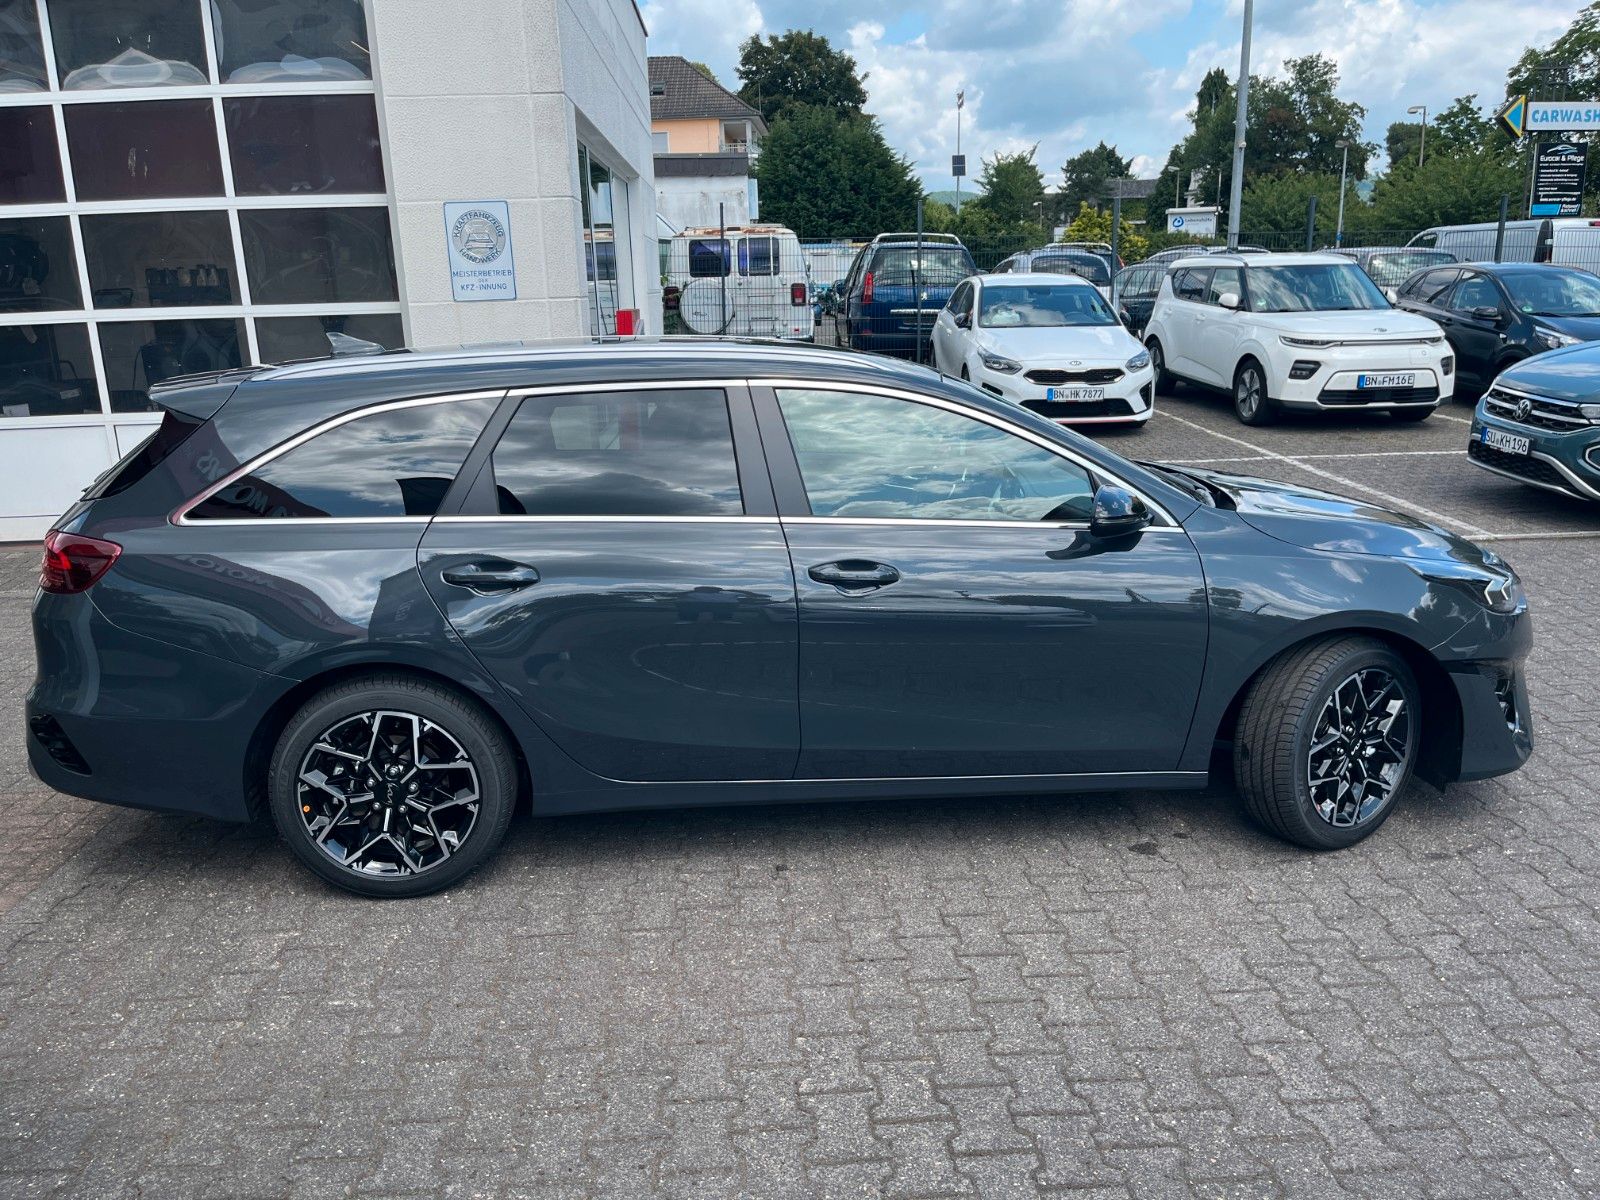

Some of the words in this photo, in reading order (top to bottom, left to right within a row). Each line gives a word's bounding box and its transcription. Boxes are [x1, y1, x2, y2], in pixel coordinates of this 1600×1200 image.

[453, 210, 504, 238] KRAFTFAHRZEUG
[459, 247, 502, 264] HANDWERK
[452, 269, 513, 278] MEISTERBETRIEB
[1365, 376, 1377, 386] BN
[1053, 389, 1065, 399] BN
[1070, 389, 1080, 399] HK
[1083, 389, 1103, 398] 7877
[1486, 431, 1496, 444] SU
[1499, 435, 1510, 448] KH
[1512, 438, 1527, 453] 196
